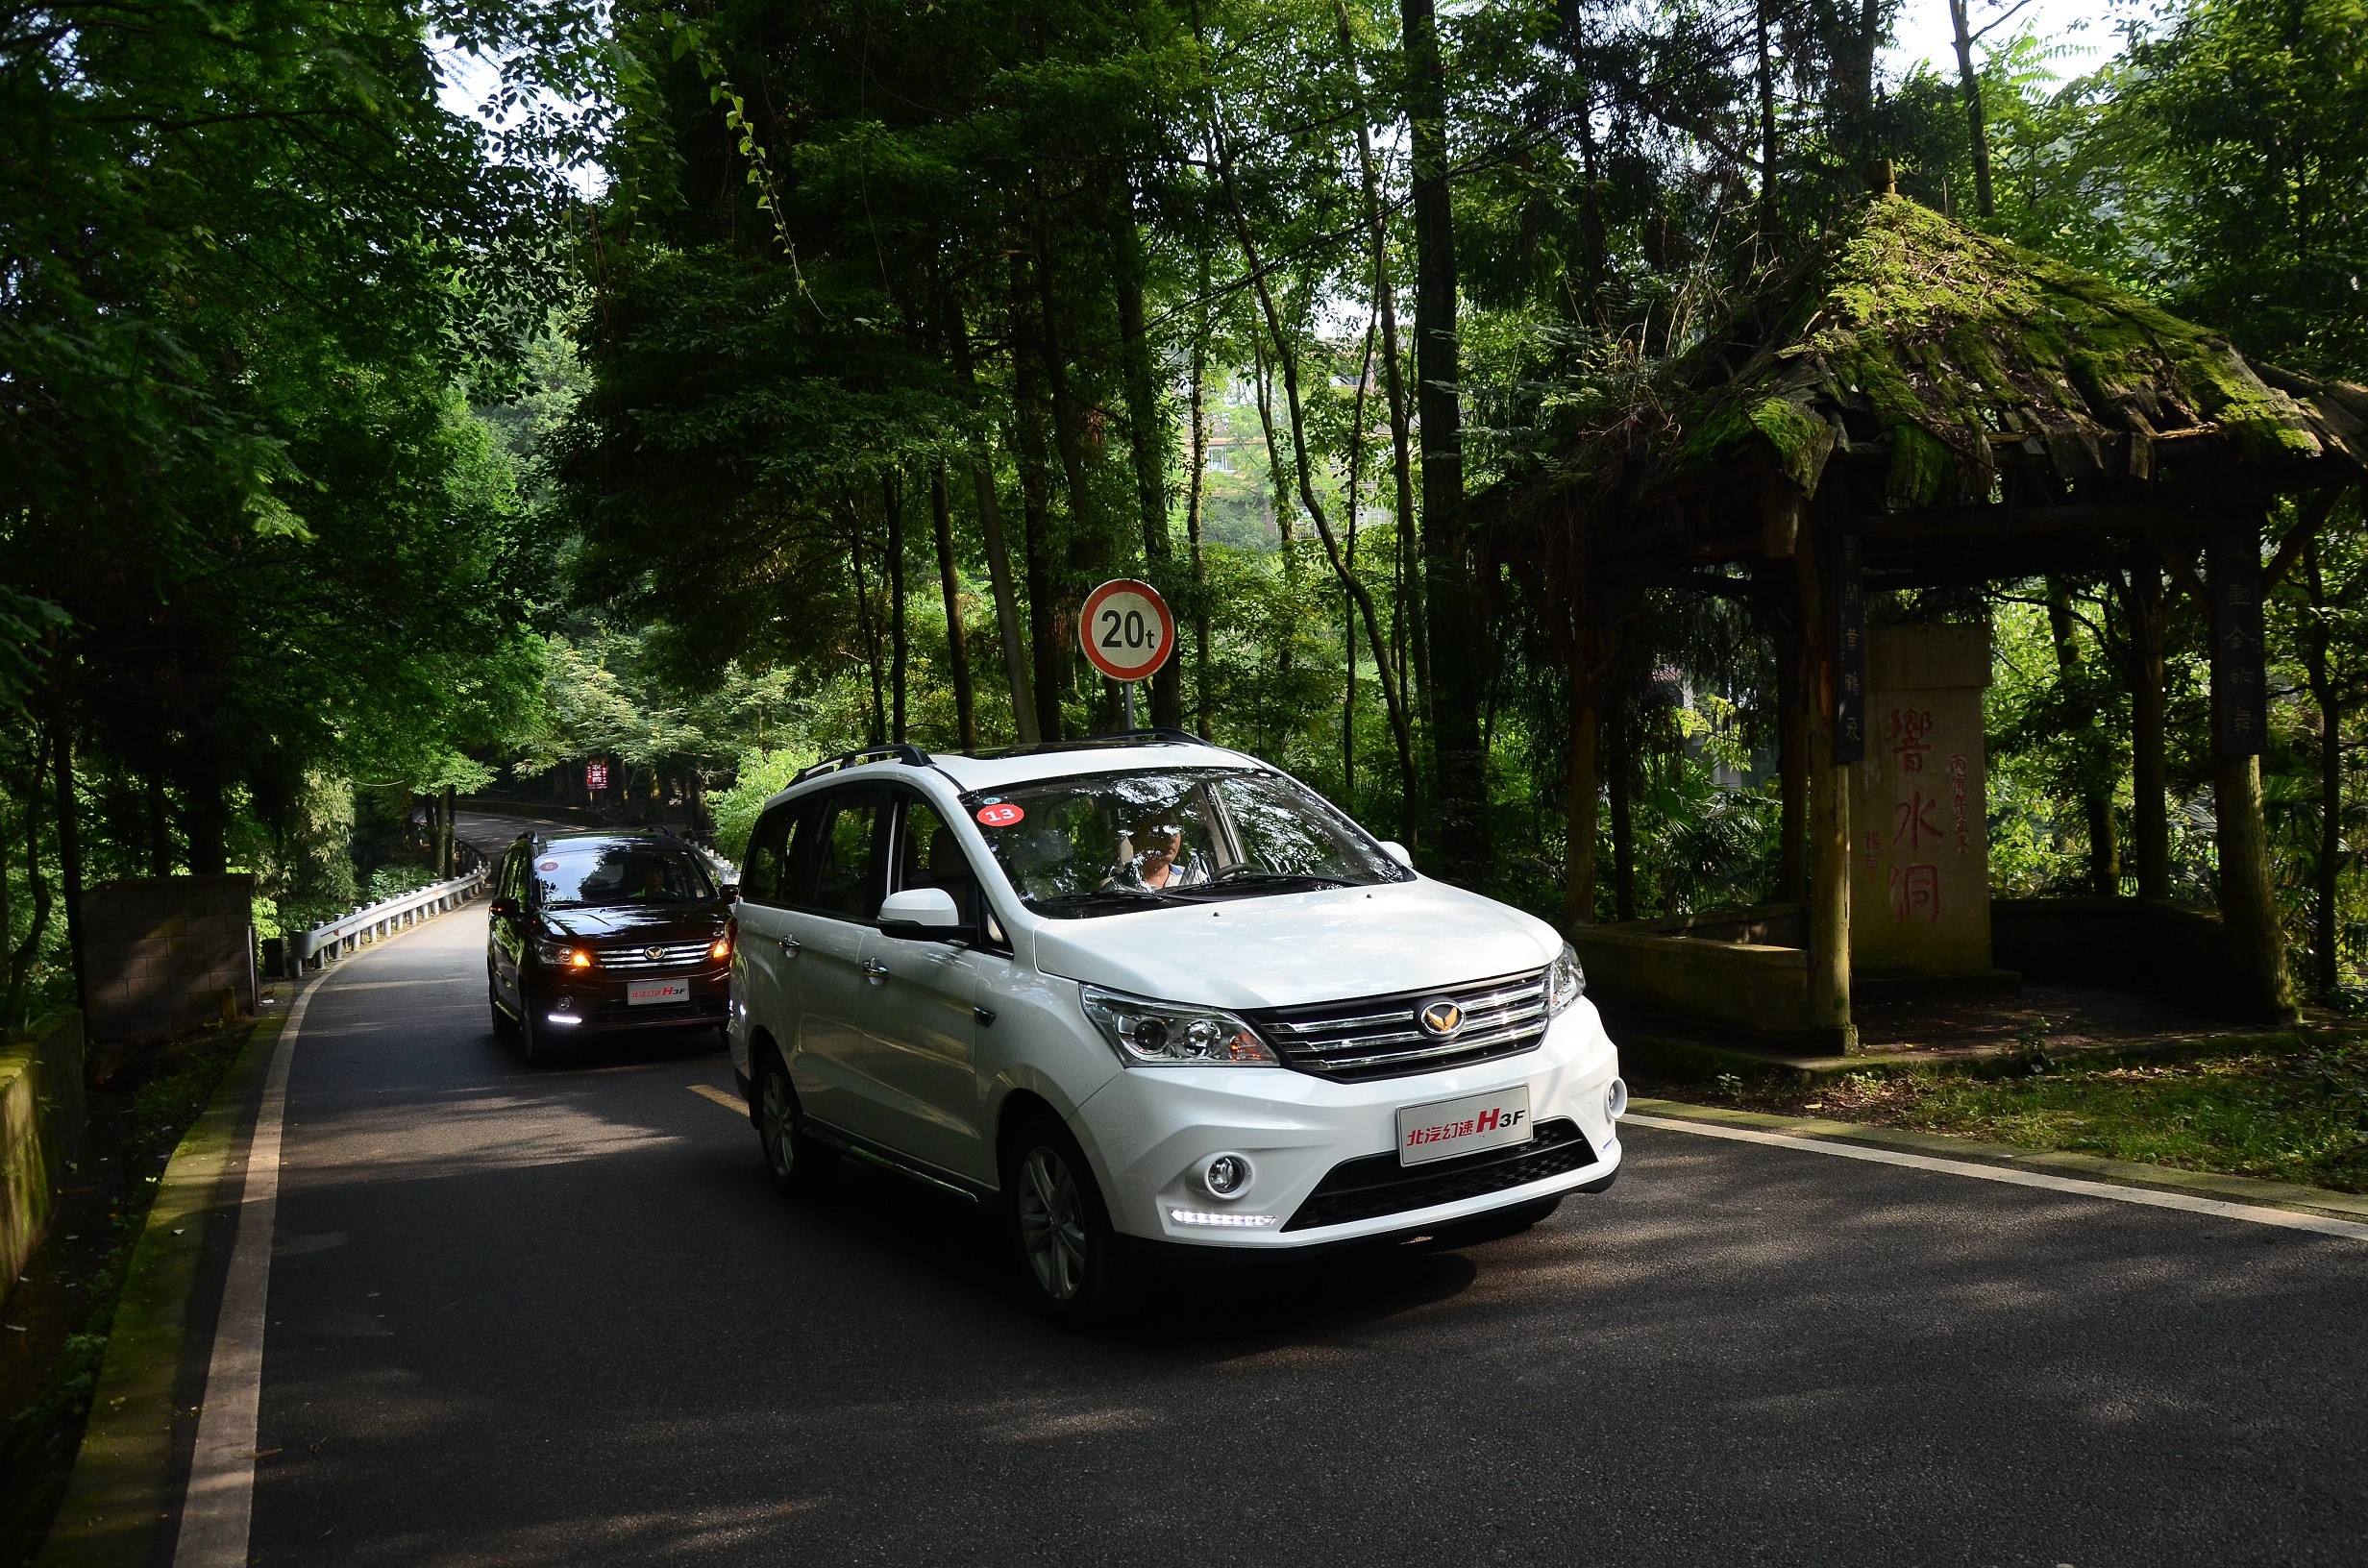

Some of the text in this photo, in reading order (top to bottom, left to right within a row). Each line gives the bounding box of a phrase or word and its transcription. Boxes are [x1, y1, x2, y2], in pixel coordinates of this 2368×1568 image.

[1101, 609, 1155, 649] 20t
[985, 808, 1015, 822] 13
[662, 987, 686, 996] H3F
[1406, 1108, 1526, 1147] 北汽幻速 H3F
